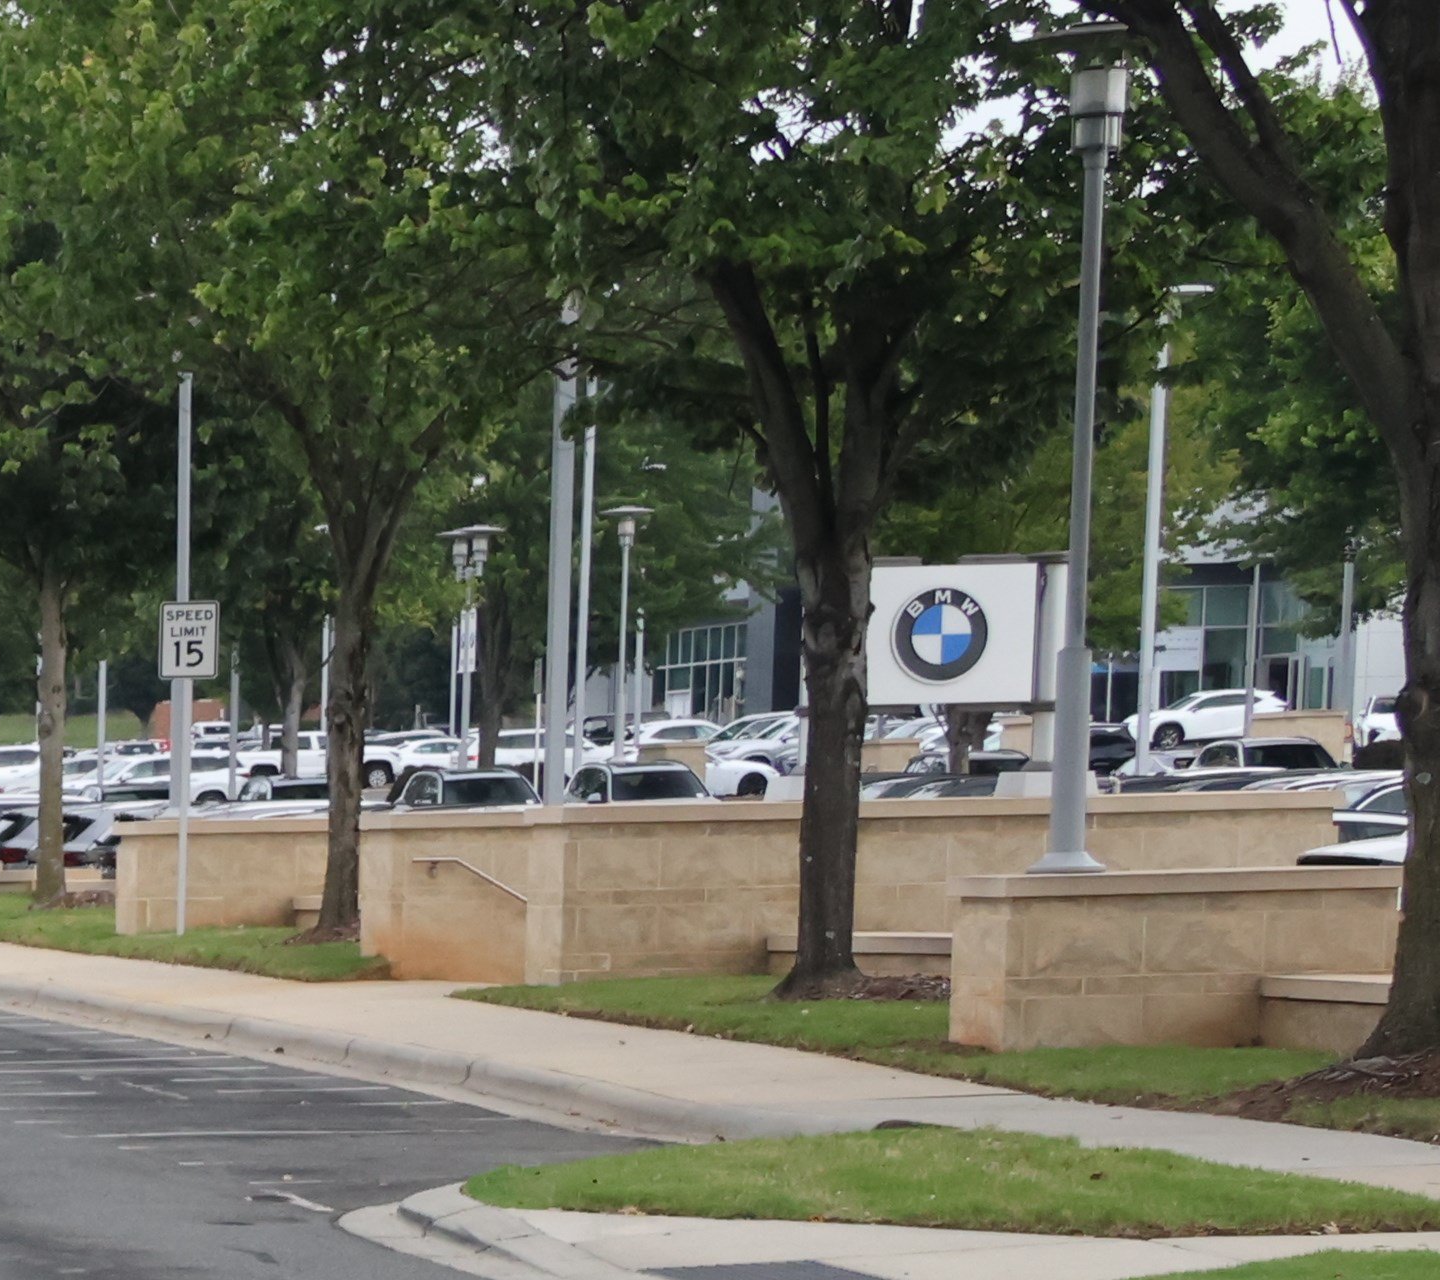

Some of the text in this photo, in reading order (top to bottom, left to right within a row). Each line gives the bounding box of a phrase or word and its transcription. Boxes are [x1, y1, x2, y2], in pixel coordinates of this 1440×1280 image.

[906, 590, 980, 619] BMW
[166, 609, 213, 621] SPEED
[170, 625, 207, 638] LIMIT
[174, 640, 204, 667] 15
